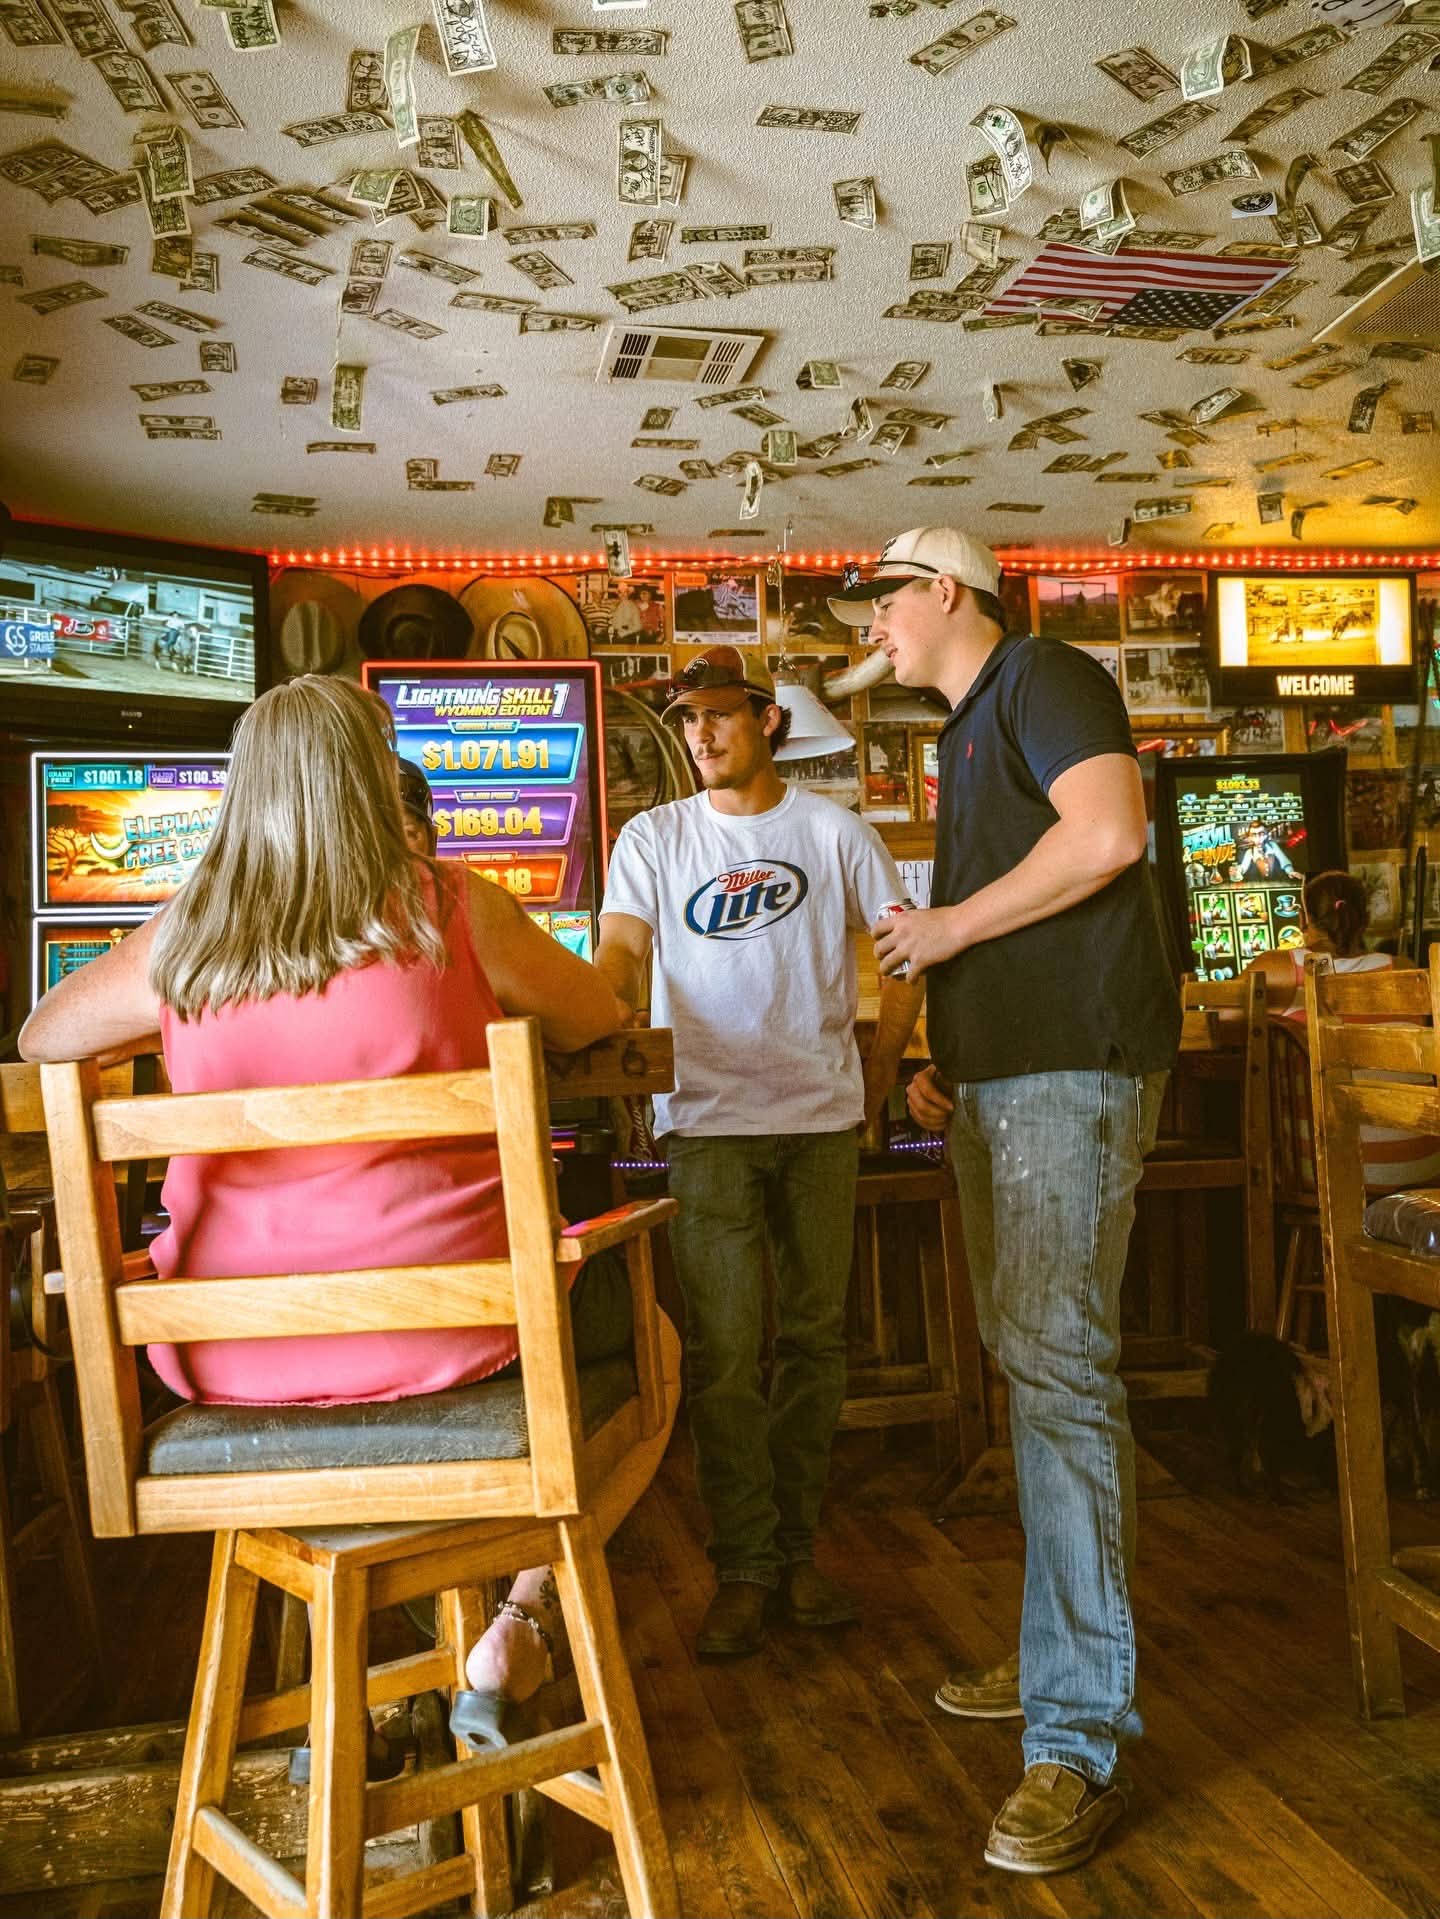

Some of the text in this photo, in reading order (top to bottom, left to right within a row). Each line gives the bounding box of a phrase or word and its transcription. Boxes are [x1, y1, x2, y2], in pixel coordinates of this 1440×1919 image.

[396, 681, 500, 708] LIGHTNING
[500, 688, 553, 705] SKILL
[1276, 675, 1355, 696] WELCOME
[434, 704, 552, 717] WYOMING EDITION
[83, 770, 143, 785] $1001.18
[124, 808, 220, 841] ELEPHAN
[433, 806, 543, 837] $169.04
[125, 840, 177, 869] FREE
[717, 870, 776, 893] Miller
[704, 882, 792, 935] Lite
